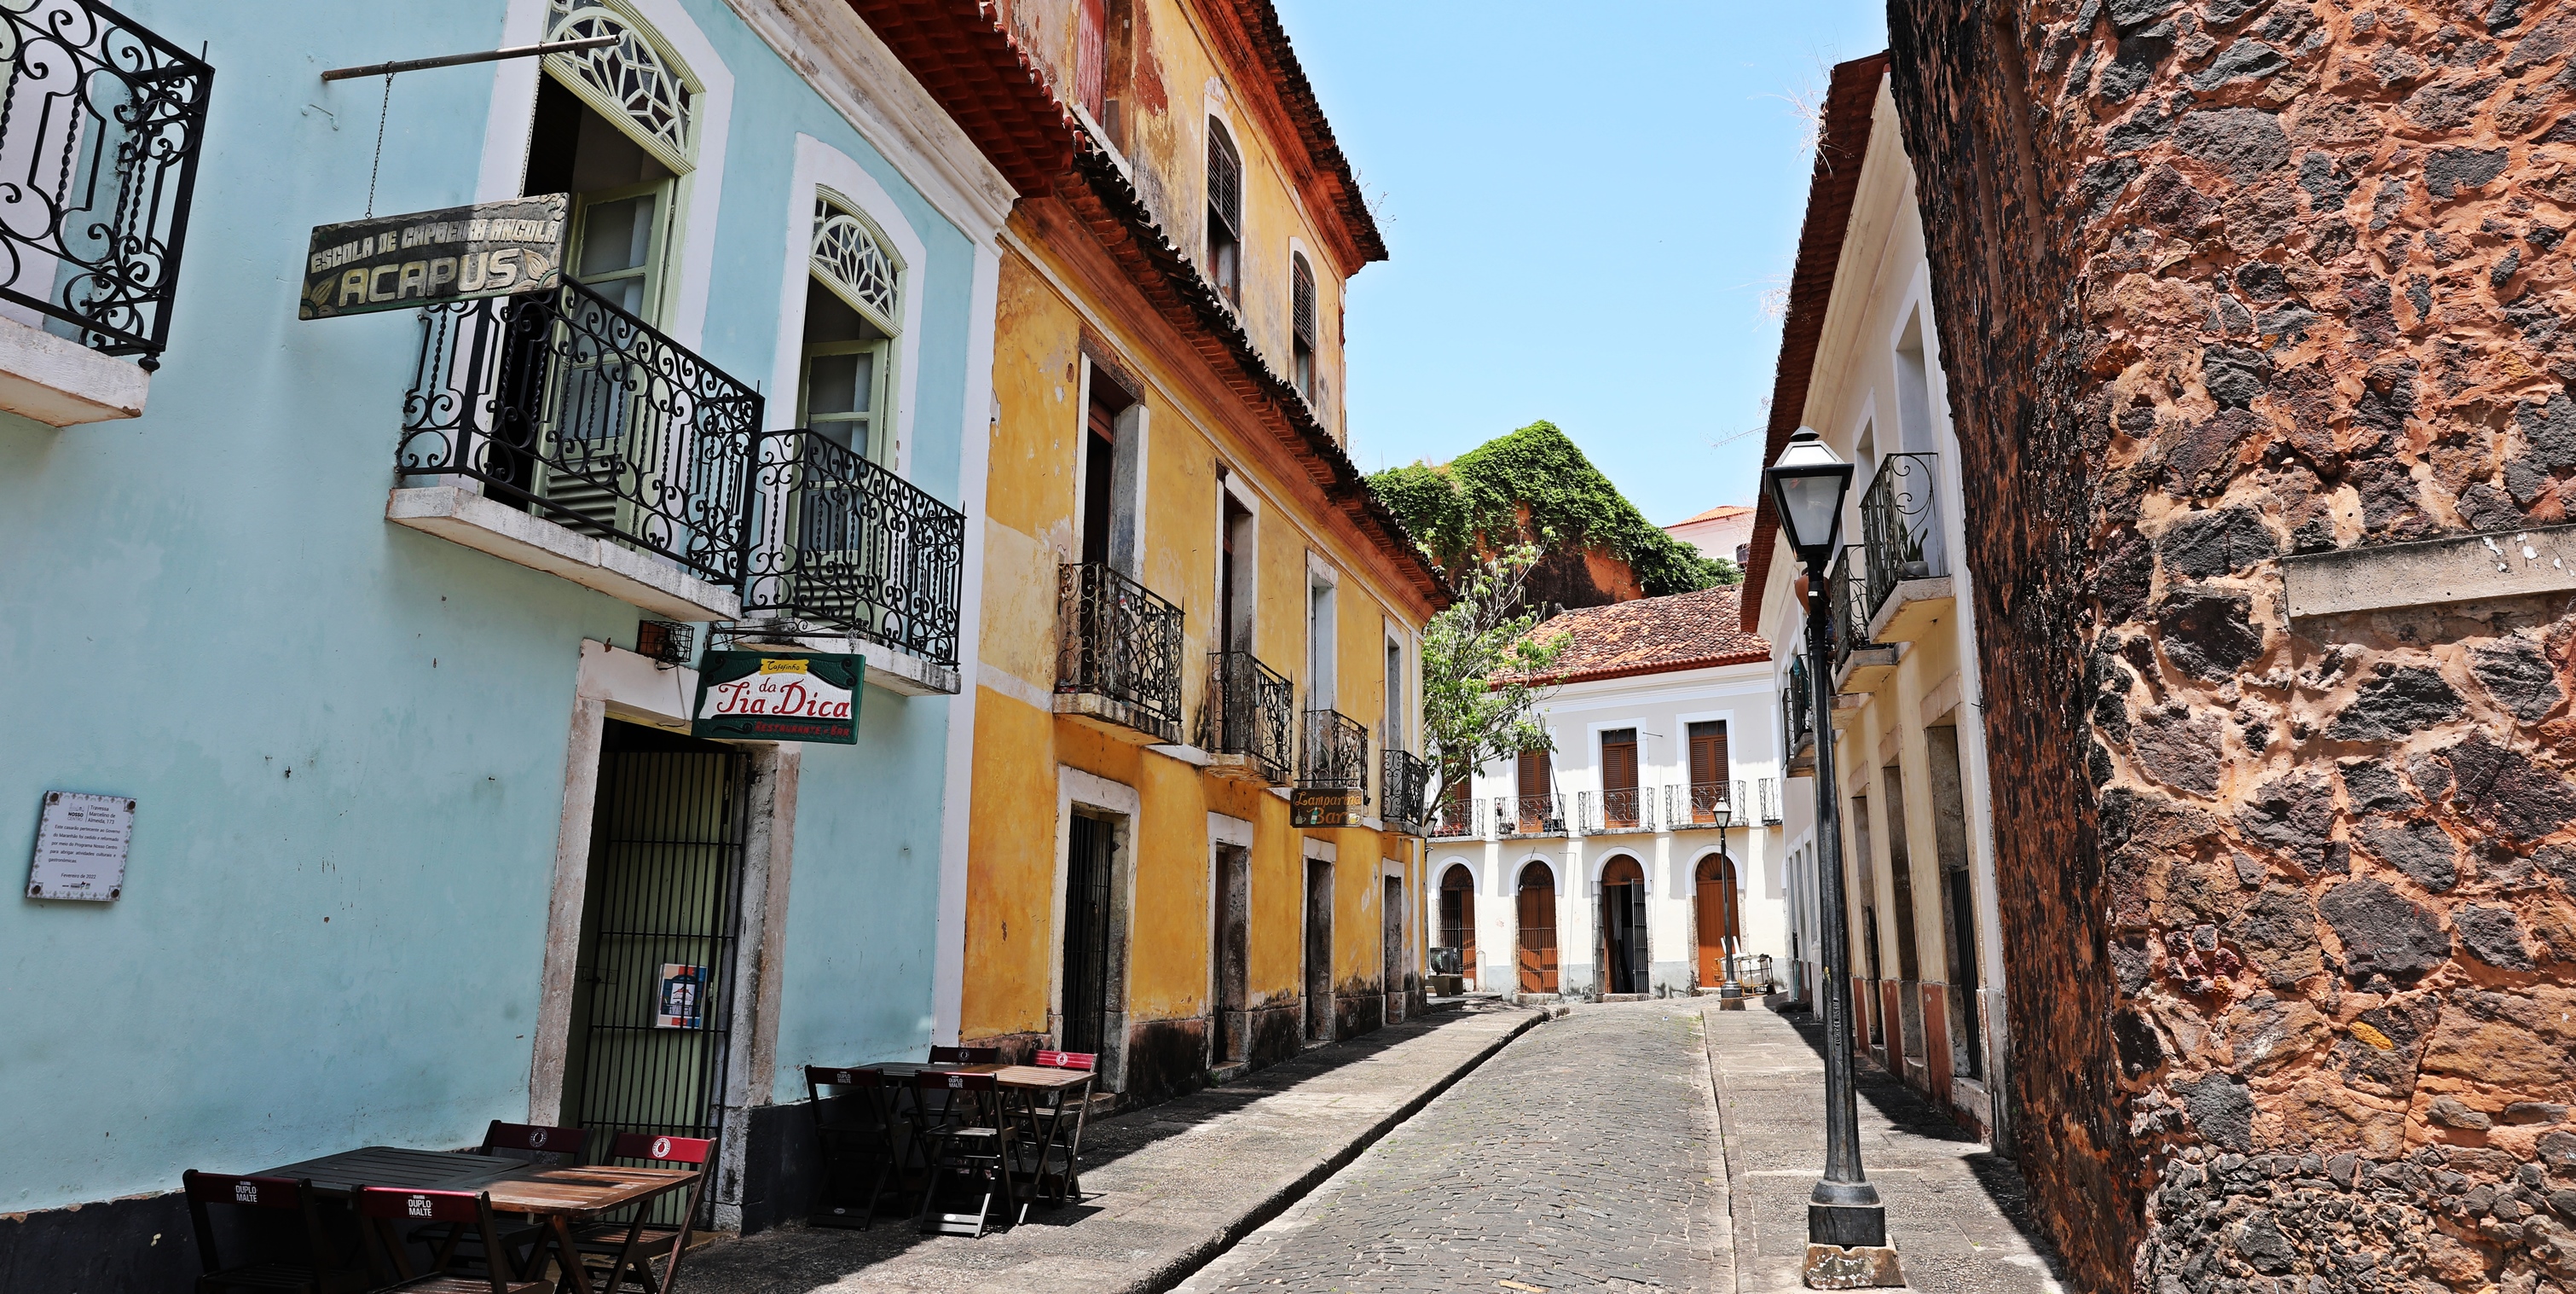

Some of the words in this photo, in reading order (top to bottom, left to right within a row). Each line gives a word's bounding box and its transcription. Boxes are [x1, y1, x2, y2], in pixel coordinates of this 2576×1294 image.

[310, 236, 374, 274] ESCOLA
[378, 230, 397, 254] DE
[401, 218, 485, 250] CAPOEIRA
[489, 218, 560, 244] ANGOLA
[338, 247, 522, 307] ACAPUS
[759, 676, 777, 693] da
[716, 682, 767, 714] Tia
[772, 678, 851, 718] Dica
[754, 721, 822, 735] RESTAURANTE
[830, 724, 851, 737] BAR
[1294, 792, 1362, 808] Lamparina
[1306, 807, 1347, 825] Bar
[235, 1185, 257, 1194] DUPLO
[236, 1193, 258, 1203] MALTE
[408, 1198, 431, 1208] DUPLO
[408, 1207, 432, 1216] MALTE
